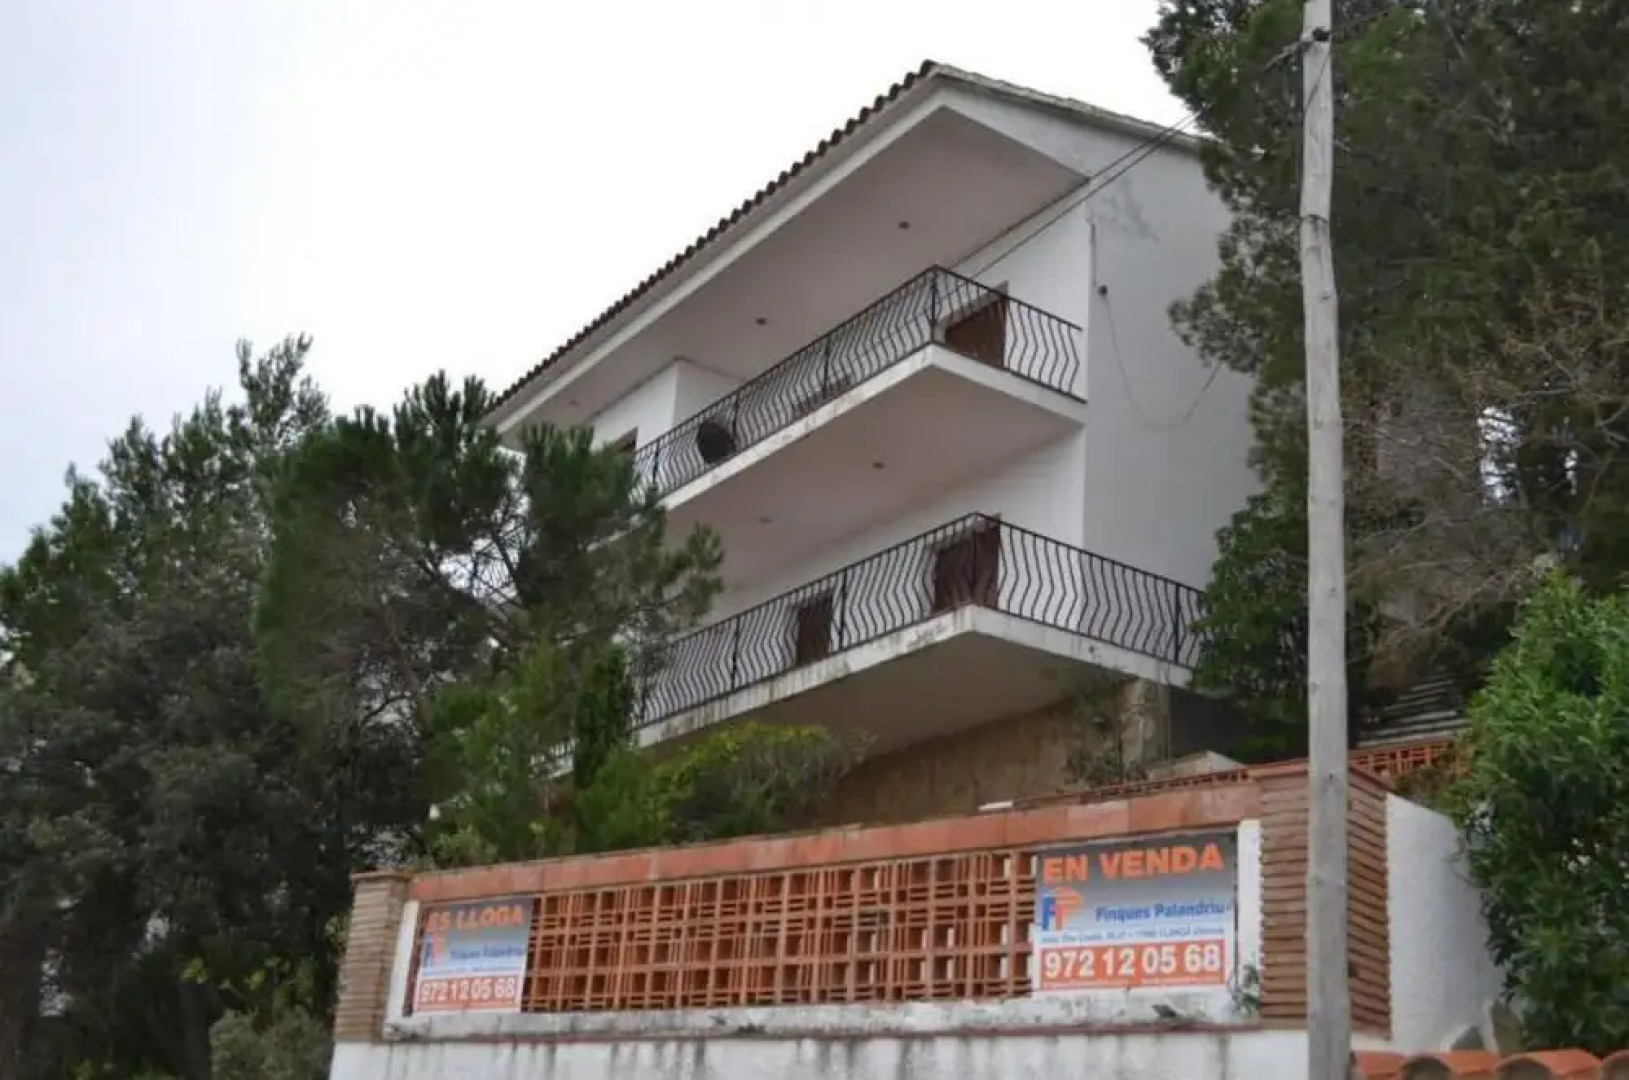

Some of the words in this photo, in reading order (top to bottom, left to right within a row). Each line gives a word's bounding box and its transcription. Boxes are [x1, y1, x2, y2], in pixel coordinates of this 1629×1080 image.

[1043, 855, 1087, 881] EN
[1099, 843, 1223, 877] VENDA
[426, 912, 450, 931] ES
[456, 906, 523, 929] LLOGA
[1095, 905, 1150, 925] Finques
[1154, 899, 1225, 919] Palandriu
[1044, 949, 1095, 979] 972
[1102, 947, 1135, 977] 12
[1141, 945, 1177, 975] 05
[1184, 943, 1220, 973] 68
[421, 980, 448, 1003] 972
[450, 979, 470, 1001] 12
[471, 978, 492, 1000] 05
[494, 977, 516, 998] 68
